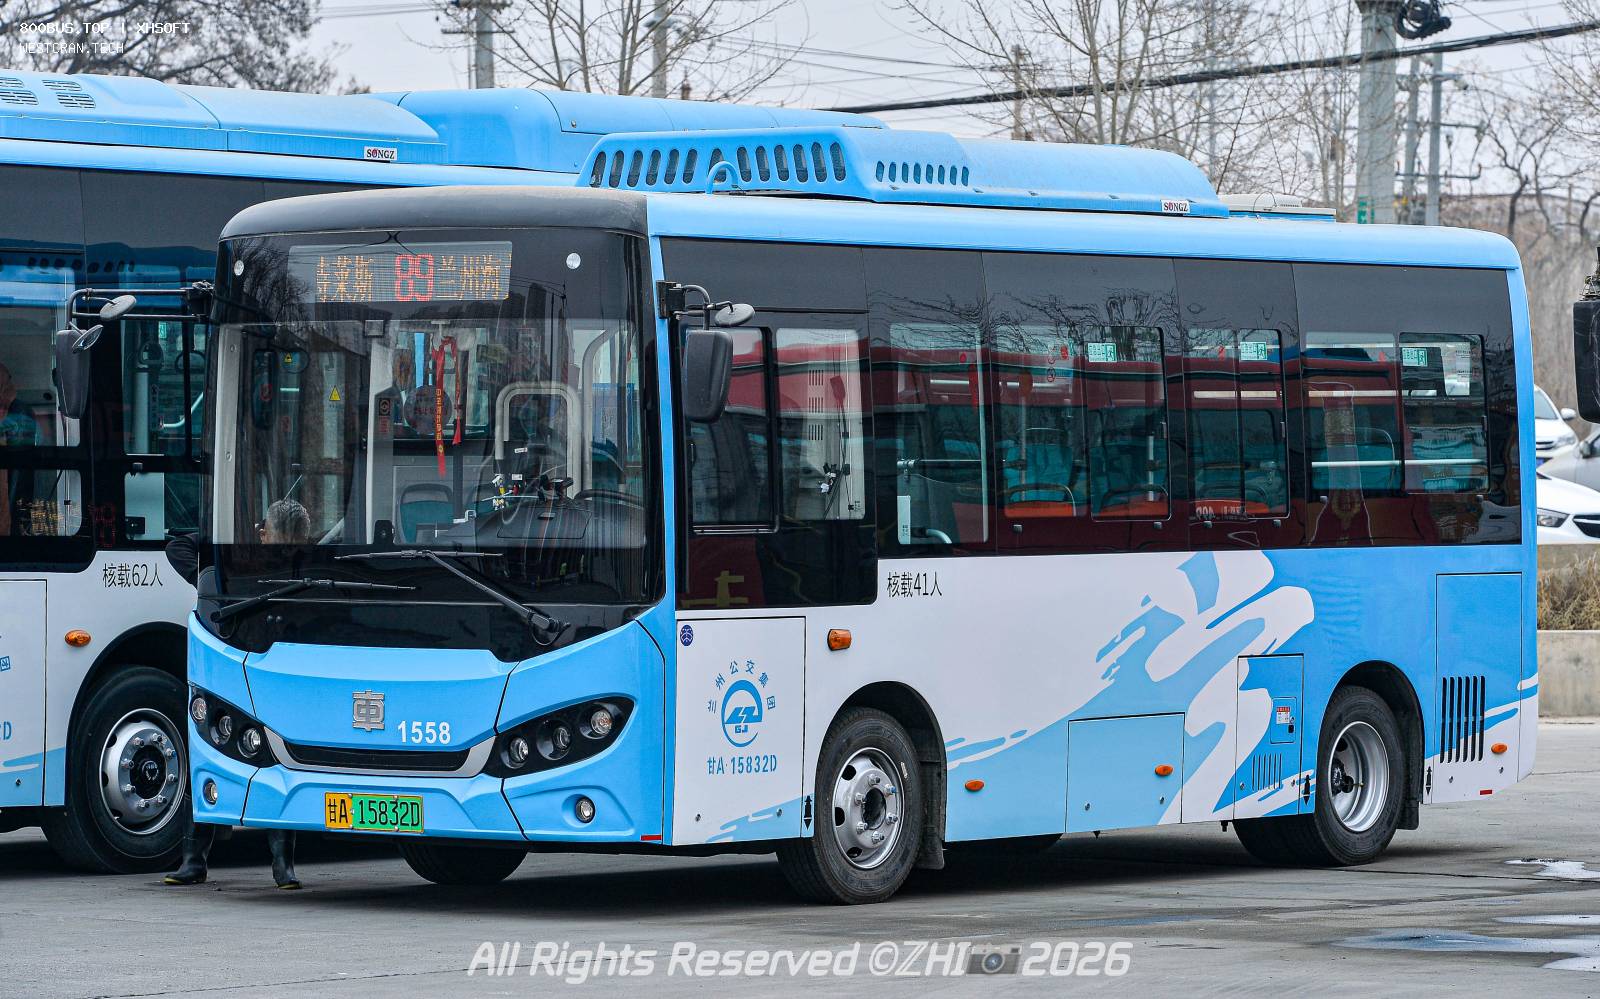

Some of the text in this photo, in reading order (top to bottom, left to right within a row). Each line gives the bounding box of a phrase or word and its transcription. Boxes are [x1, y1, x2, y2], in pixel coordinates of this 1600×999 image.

[367, 148, 394, 159] SONGZ
[1163, 202, 1188, 212] SONGZ
[394, 253, 435, 301] 89
[102, 563, 163, 587] 核载62人
[886, 571, 942, 597] 核载41人
[397, 721, 451, 744] 1558
